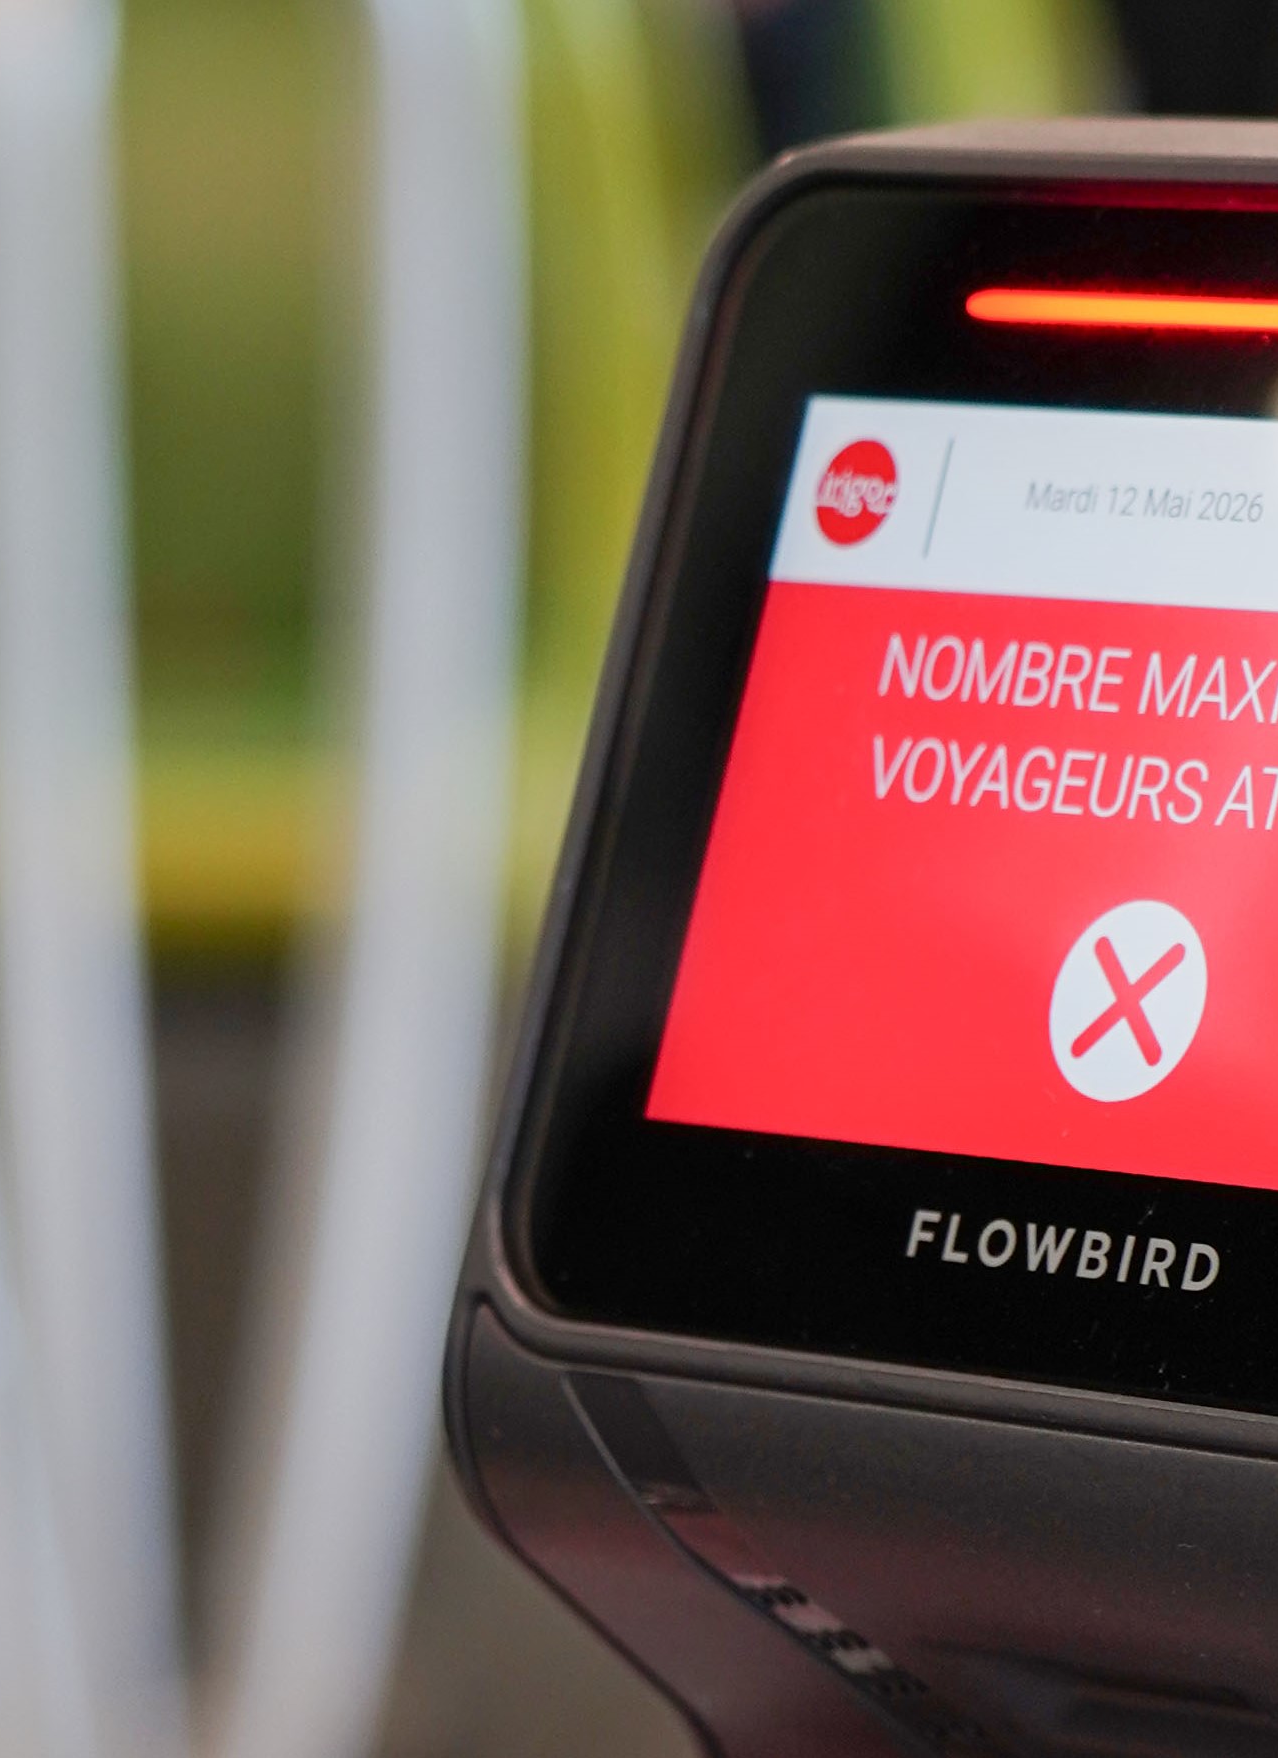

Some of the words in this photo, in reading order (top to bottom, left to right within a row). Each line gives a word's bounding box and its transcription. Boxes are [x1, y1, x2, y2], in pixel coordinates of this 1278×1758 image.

[1025, 481, 1099, 514] Mardi
[1108, 486, 1138, 517] 12
[1142, 488, 1193, 519] Mai
[1197, 491, 1265, 523] 2026
[877, 632, 1132, 714] NOMBRE
[873, 734, 1210, 825] VOYAGEURS
[905, 1209, 1221, 1292] FLOWBIRD
